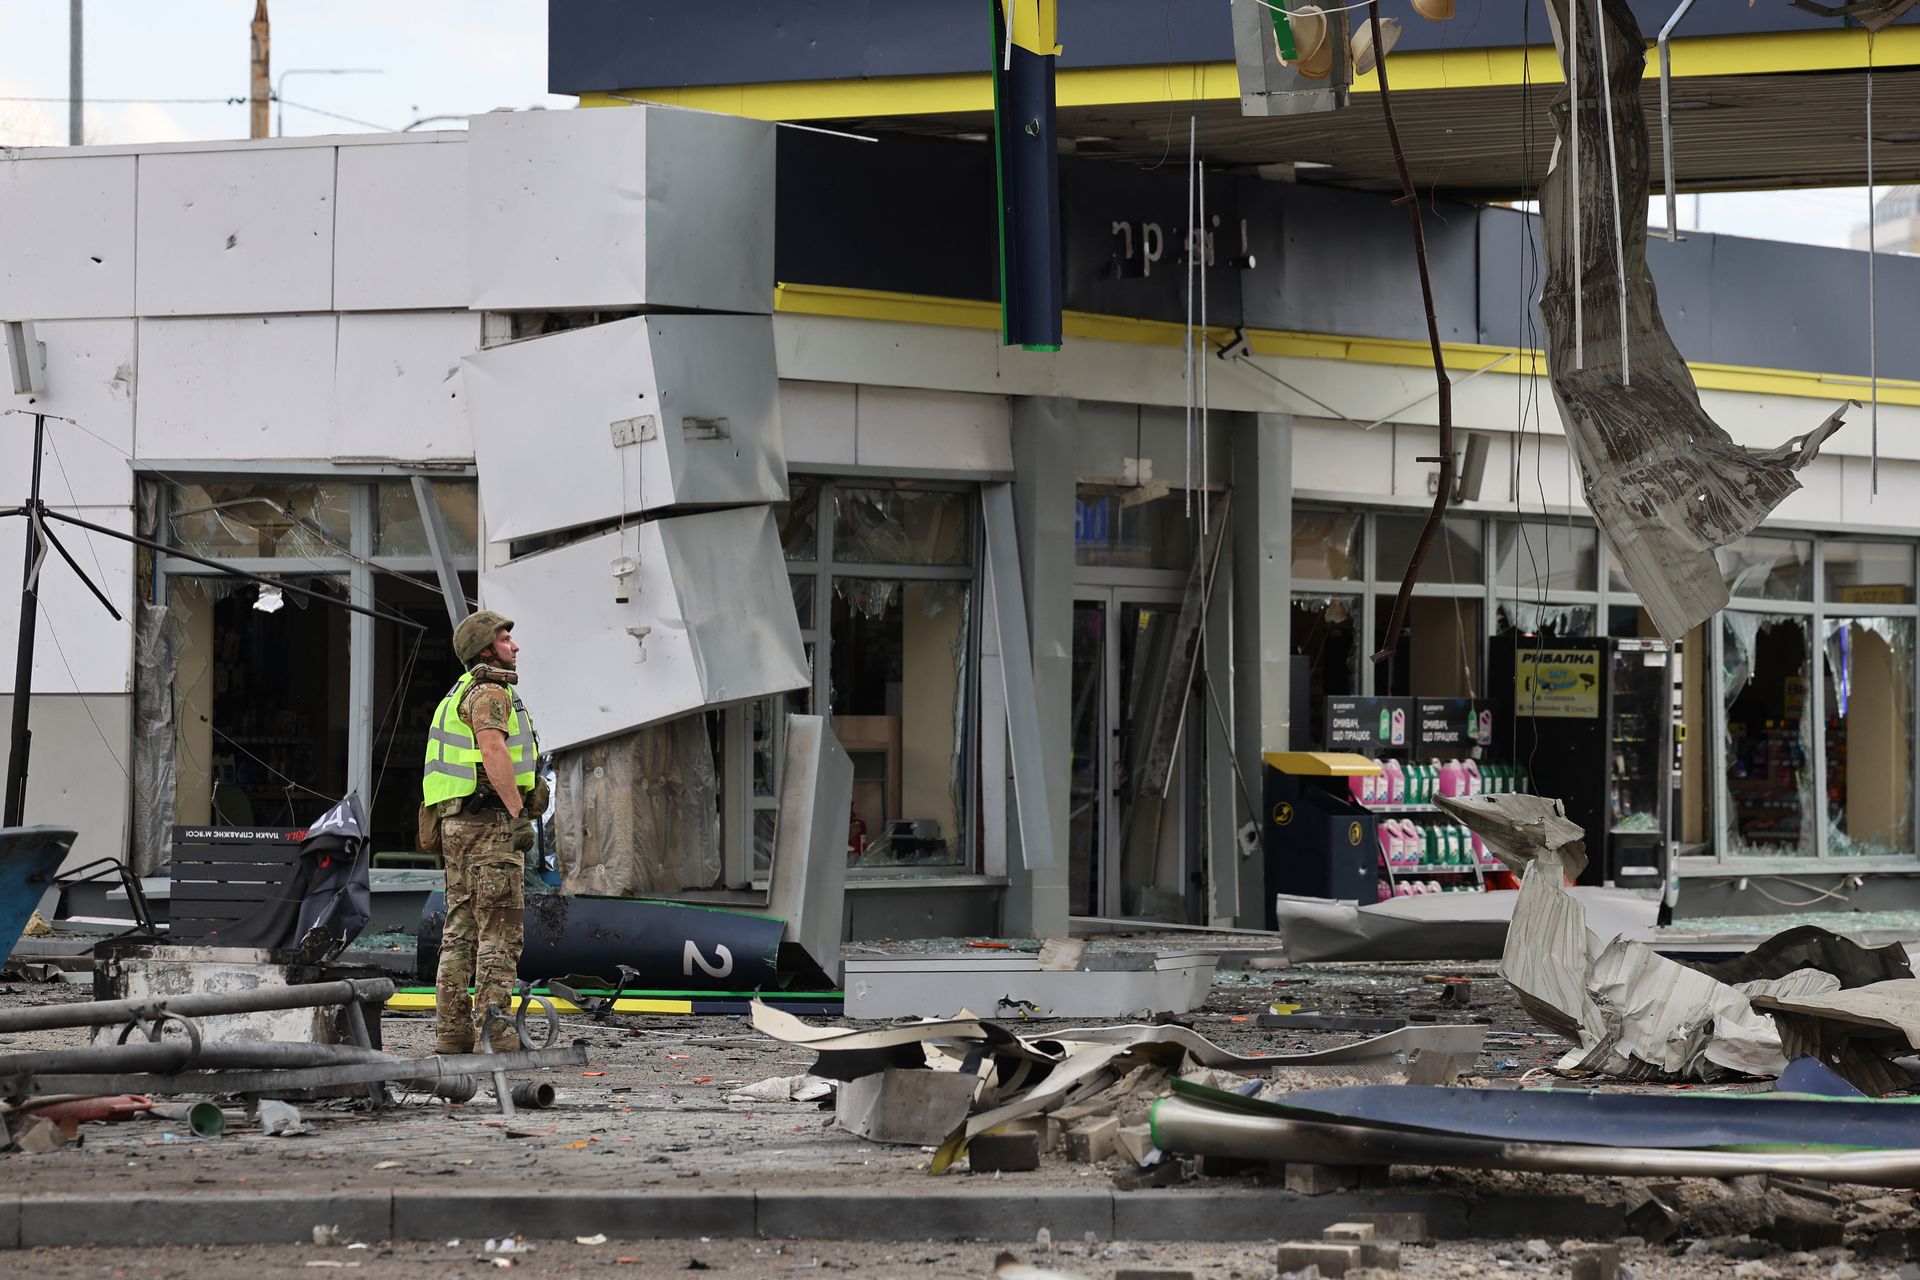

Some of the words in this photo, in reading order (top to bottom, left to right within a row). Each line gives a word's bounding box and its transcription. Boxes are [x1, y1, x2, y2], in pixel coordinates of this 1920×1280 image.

[1522, 653, 1594, 664] РИБАЛКА
[213, 831, 254, 839] СПРАВЖНЄ
[683, 940, 733, 978] 2
